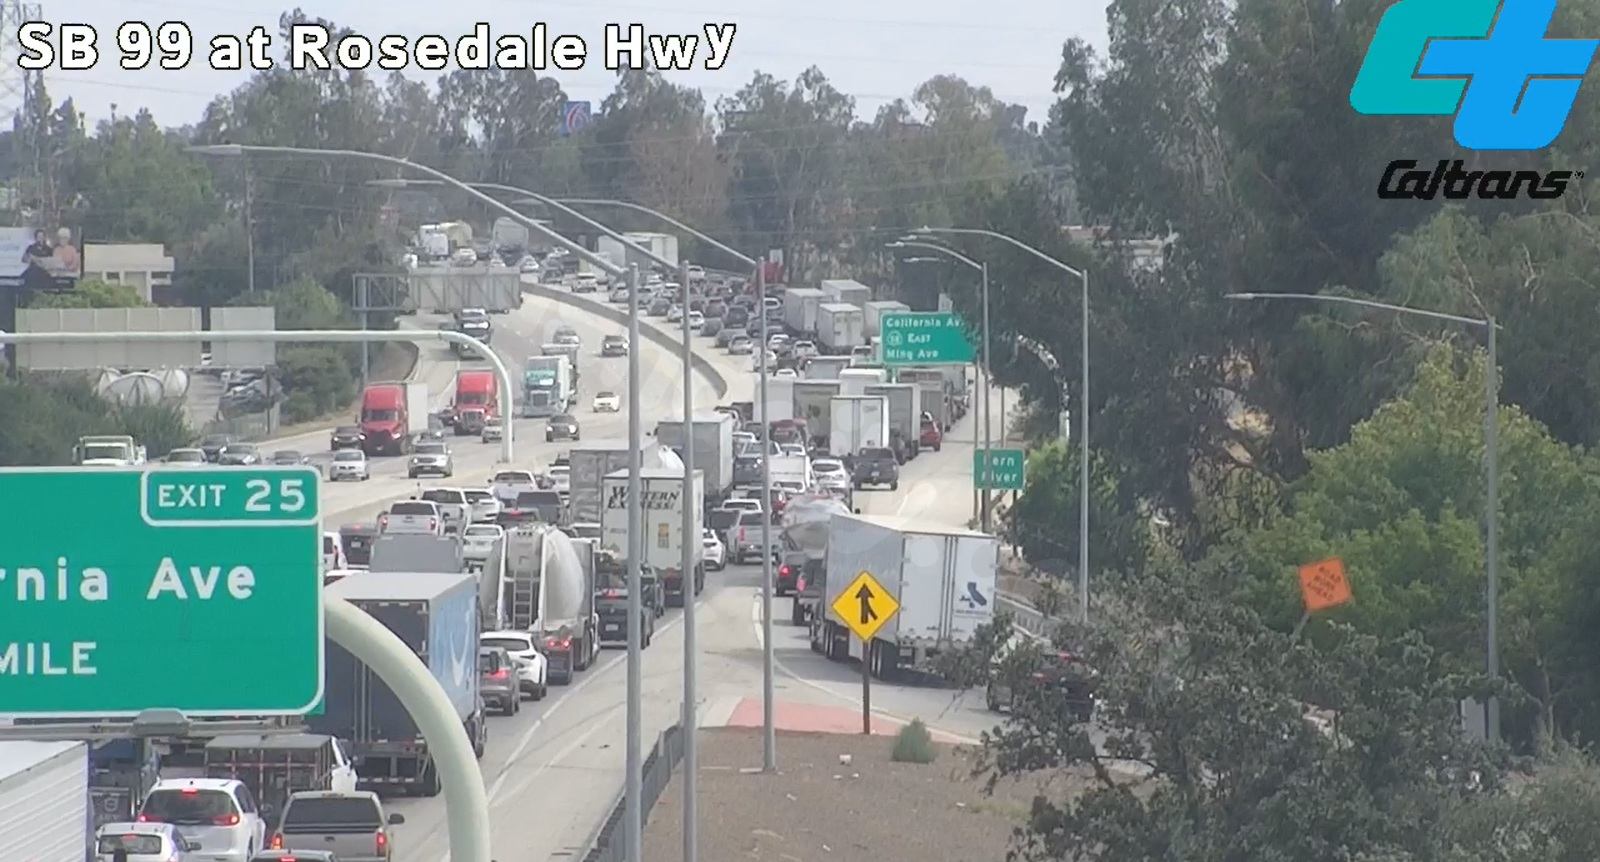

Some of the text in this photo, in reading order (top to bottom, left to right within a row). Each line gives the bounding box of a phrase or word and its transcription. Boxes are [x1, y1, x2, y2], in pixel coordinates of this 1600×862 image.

[886, 317, 961, 329] California Av
[886, 349, 939, 360] Ming Ave
[158, 479, 306, 512] EXIT 25
[613, 486, 680, 500] WTERN
[0, 556, 256, 601] nia Ave
[0, 641, 97, 675] MILE
